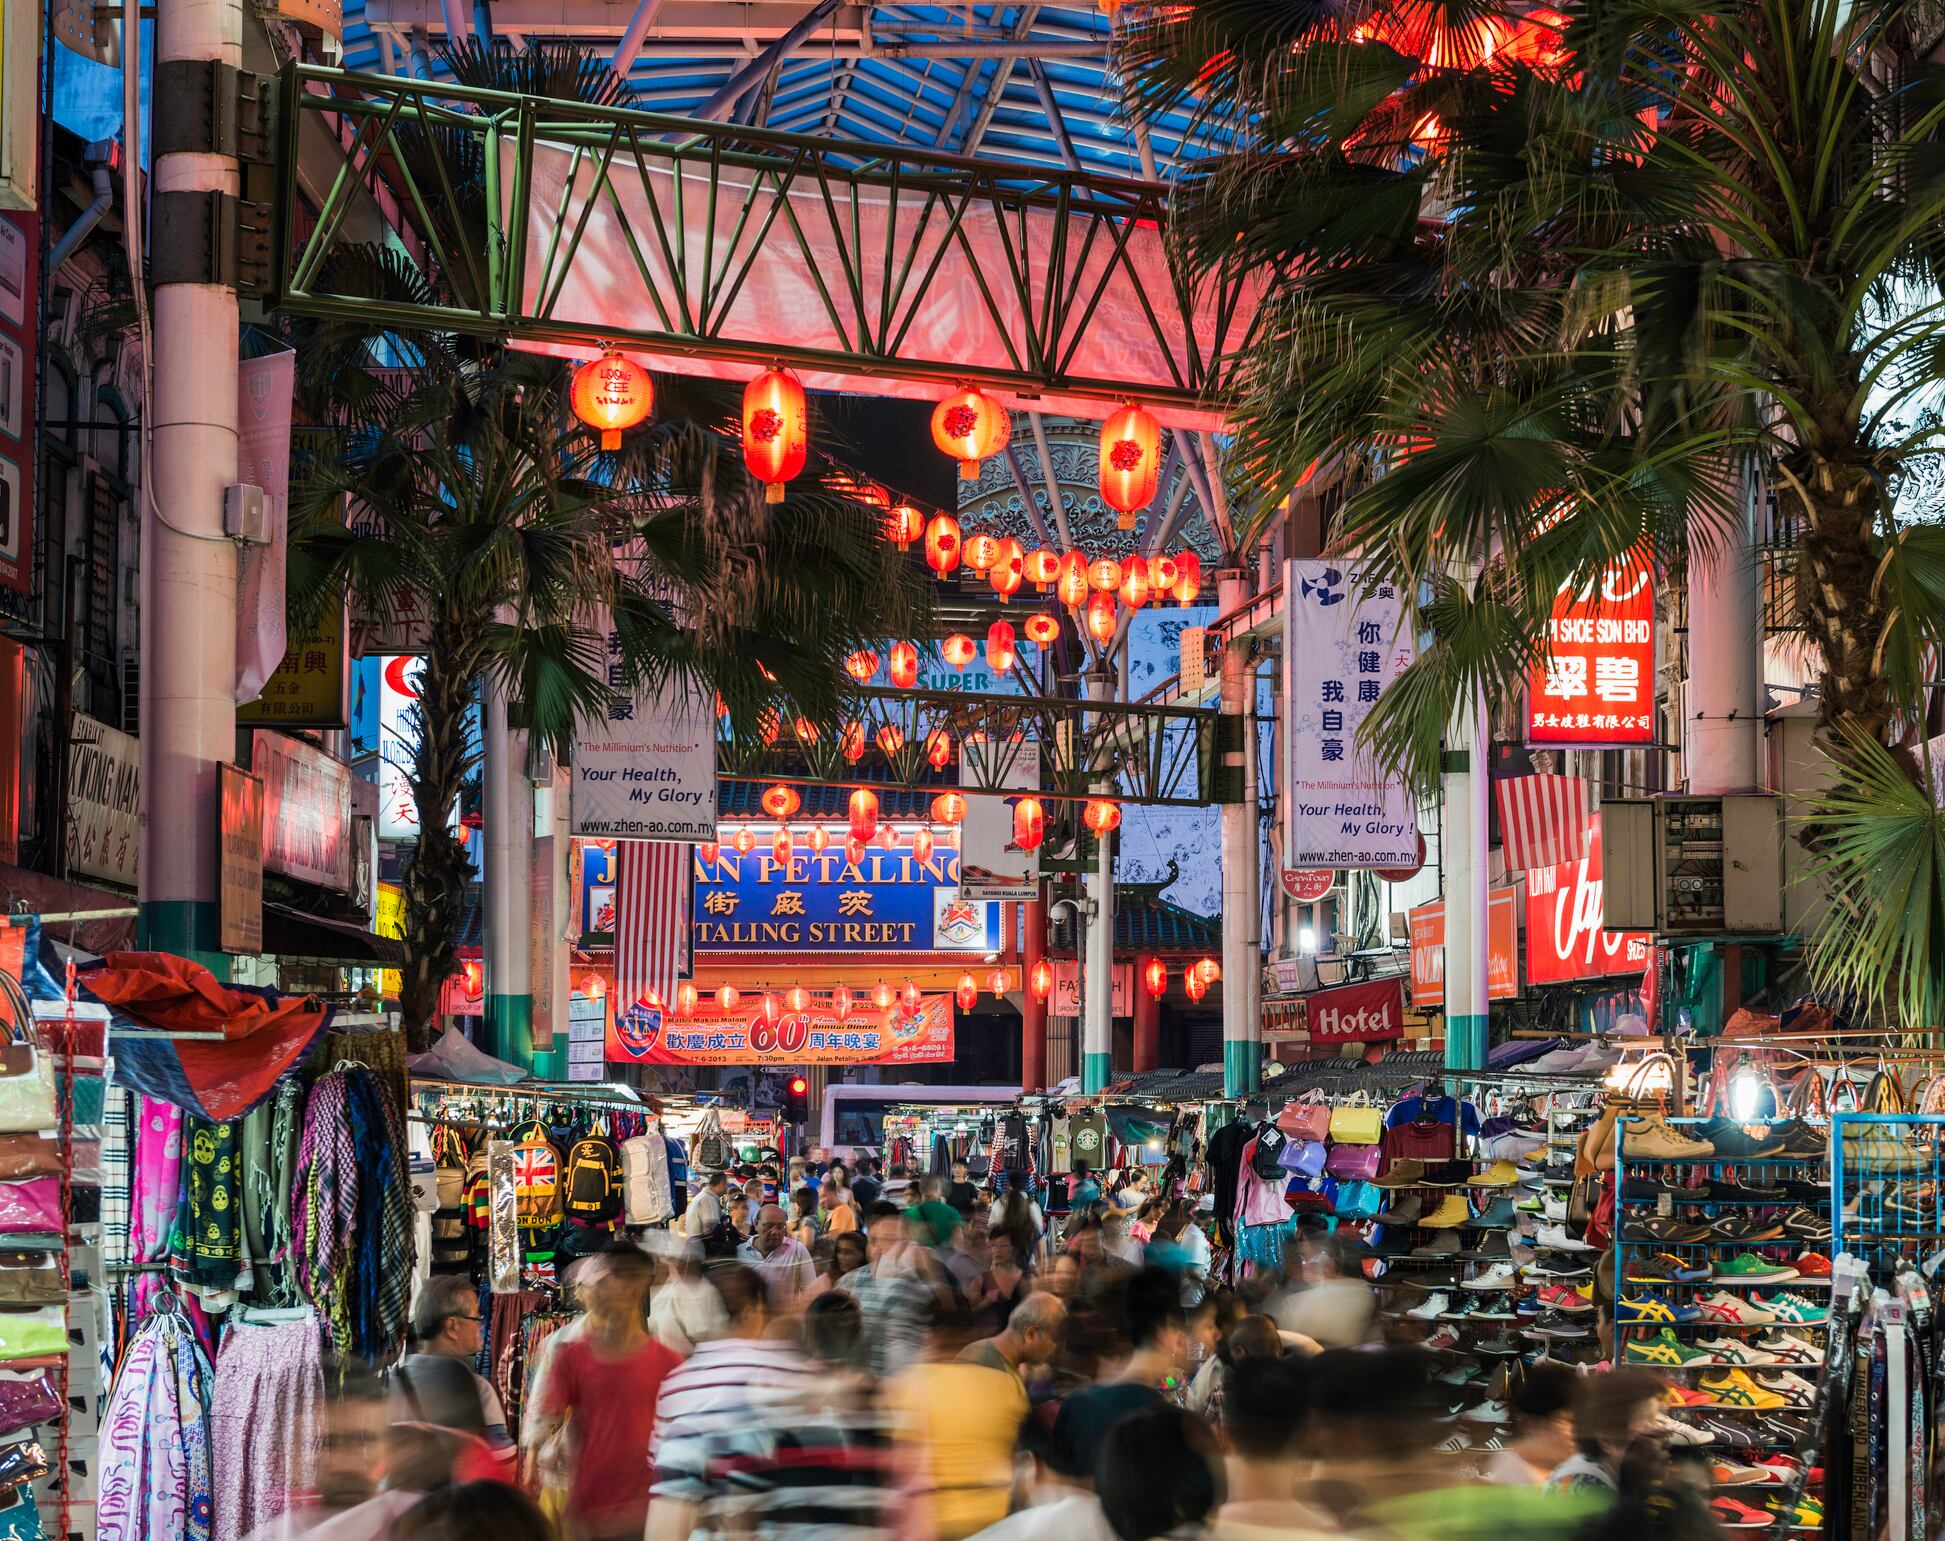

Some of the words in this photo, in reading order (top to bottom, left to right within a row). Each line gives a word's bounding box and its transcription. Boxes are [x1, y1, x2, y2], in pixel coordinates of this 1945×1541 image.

[600, 368, 632, 381] LOONG
[603, 381, 629, 393] KEE
[1560, 619, 1594, 643] SHOE
[1596, 619, 1623, 643] SDN
[1624, 620, 1650, 644] BHD
[1358, 622, 1381, 703] 你健康
[916, 672, 989, 691] SUPER
[259, 701, 315, 716] 有限公司
[1322, 680, 1344, 762] 我自豪
[1531, 712, 1651, 730] 男女皮鞋有限公司
[602, 742, 651, 753] Millinium's
[653, 743, 693, 754] Nutrition
[67, 745, 115, 807] KWONG
[581, 768, 617, 782] Your
[622, 768, 683, 784] Health,
[1316, 781, 1359, 790] Millinium's
[629, 788, 652, 804] My
[658, 789, 703, 805] Glory
[1299, 804, 1330, 816] Your
[1335, 804, 1386, 818] Health,
[580, 818, 717, 838] www.zhen-ao.com.my
[1341, 822, 1361, 837] My
[1365, 822, 1403, 837] Glory
[1300, 850, 1417, 866] www.zhen-ao.com.my
[597, 855, 742, 884] JAN
[696, 922, 800, 943] TALING
[809, 922, 915, 943] STREET
[1626, 937, 1646, 961] SHOES
[1320, 1002, 1392, 1035] Hotel
[666, 1033, 747, 1051] 歡慶成立
[809, 1032, 881, 1050] 周年晚宴
[757, 1055, 785, 1063] 7:30pm
[1855, 1368, 1867, 1446] TIMBERLAND
[1852, 1455, 1868, 1532] TIMBERLAND
